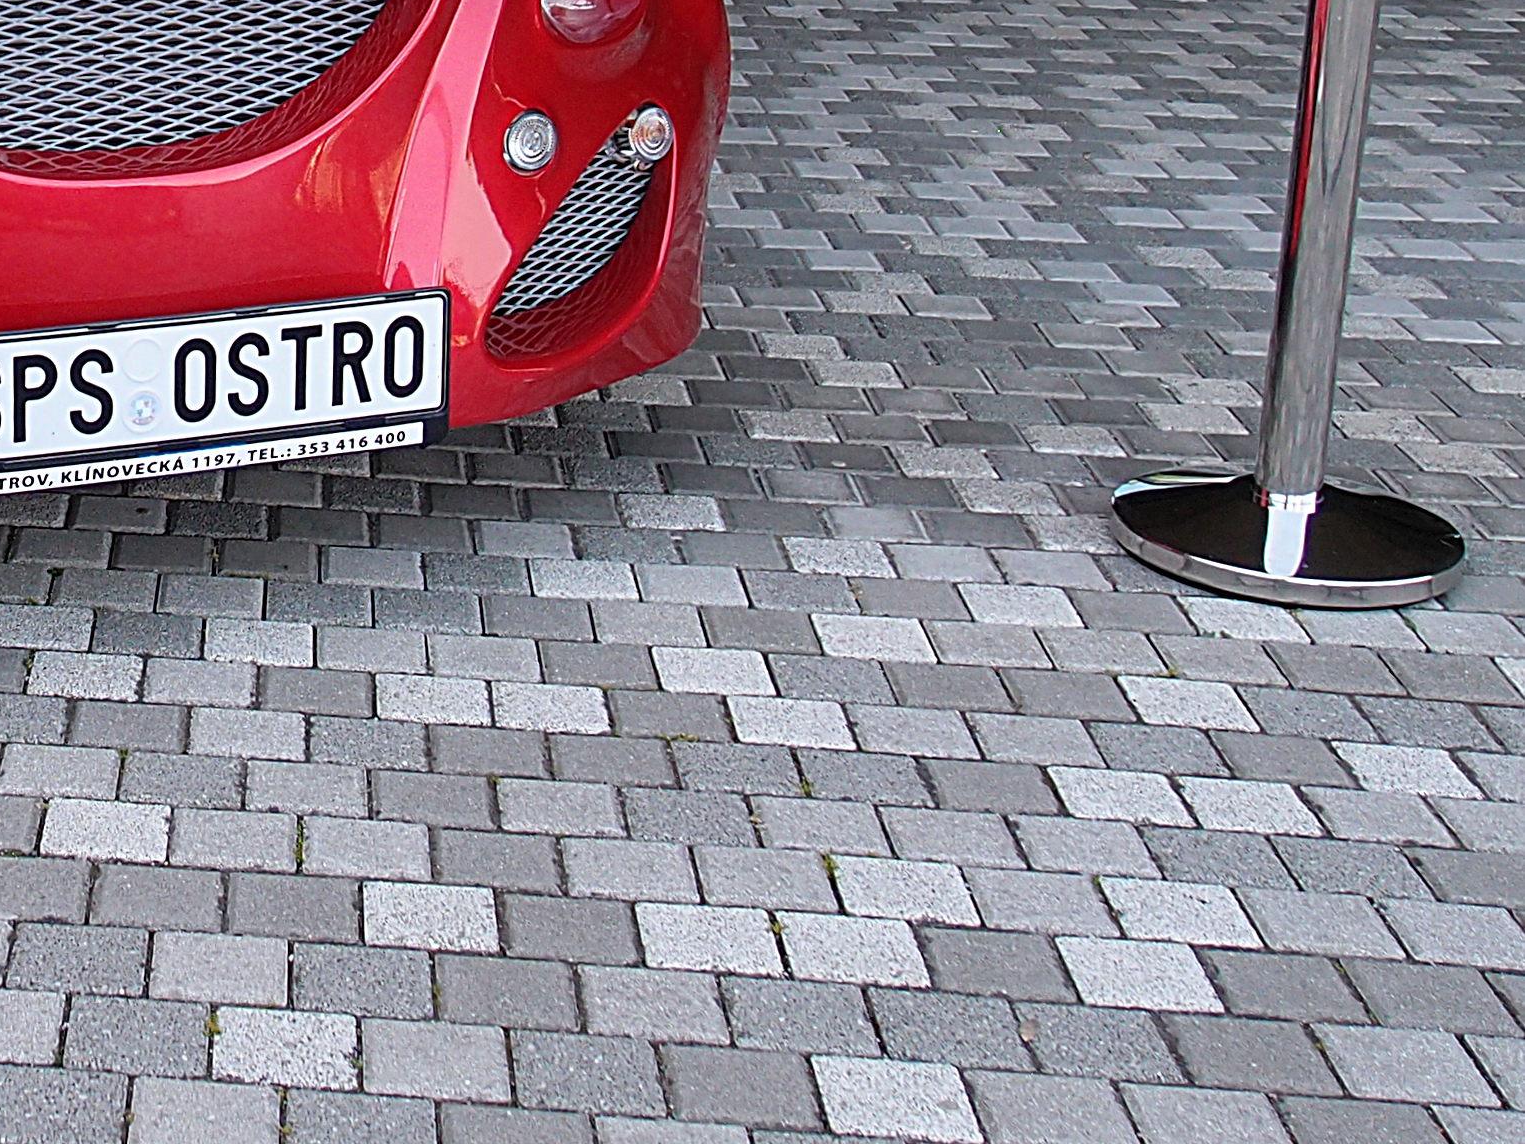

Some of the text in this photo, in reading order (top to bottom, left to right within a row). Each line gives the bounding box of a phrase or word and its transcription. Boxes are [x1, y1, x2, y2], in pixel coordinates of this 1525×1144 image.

[173, 314, 425, 424] OSTRO
[60, 451, 185, 483] KLÍNOVECKÁ
[191, 450, 244, 471] 1197,
[248, 444, 292, 463] TEL.:
[297, 439, 332, 456] 353
[335, 435, 369, 451] 416
[375, 430, 407, 446] 400
